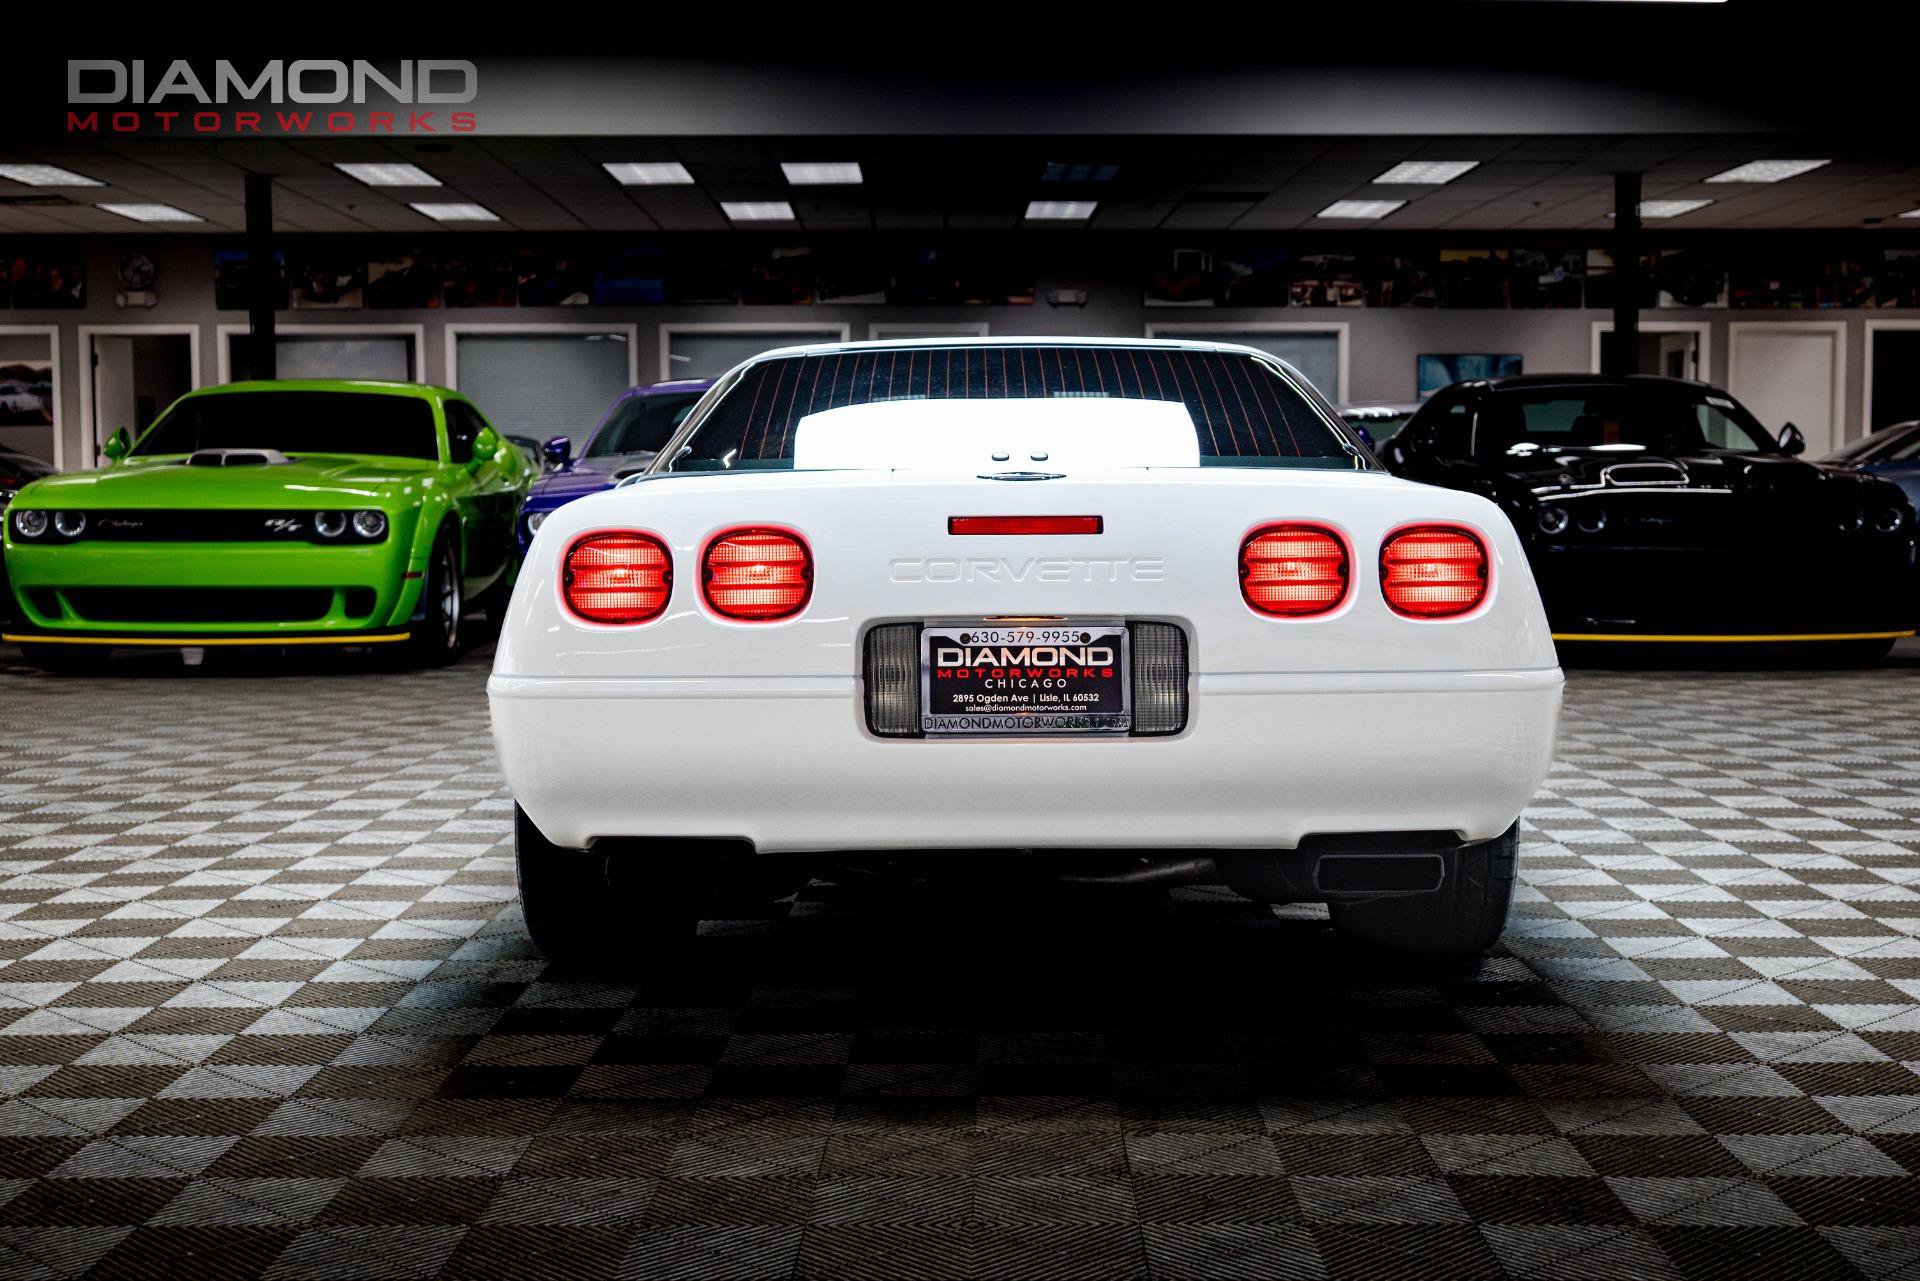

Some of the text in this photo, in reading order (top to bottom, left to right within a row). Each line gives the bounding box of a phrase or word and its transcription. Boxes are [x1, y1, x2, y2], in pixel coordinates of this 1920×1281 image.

[888, 556, 1166, 584] CORVETTE
[971, 631, 1080, 643] 630-579-9955
[937, 647, 1114, 667] DIAMOND
[938, 668, 1114, 678] MOTORWORKS
[985, 679, 1067, 688] CHICAGO
[952, 694, 974, 702] 2895
[976, 694, 1009, 704] Ogden
[1011, 694, 1029, 702] Ave
[1039, 694, 1061, 703] Lisle,
[1063, 694, 1070, 702] IL
[1072, 693, 1099, 702] 60532
[965, 704, 1087, 713] sales@diamondmotorworks.com
